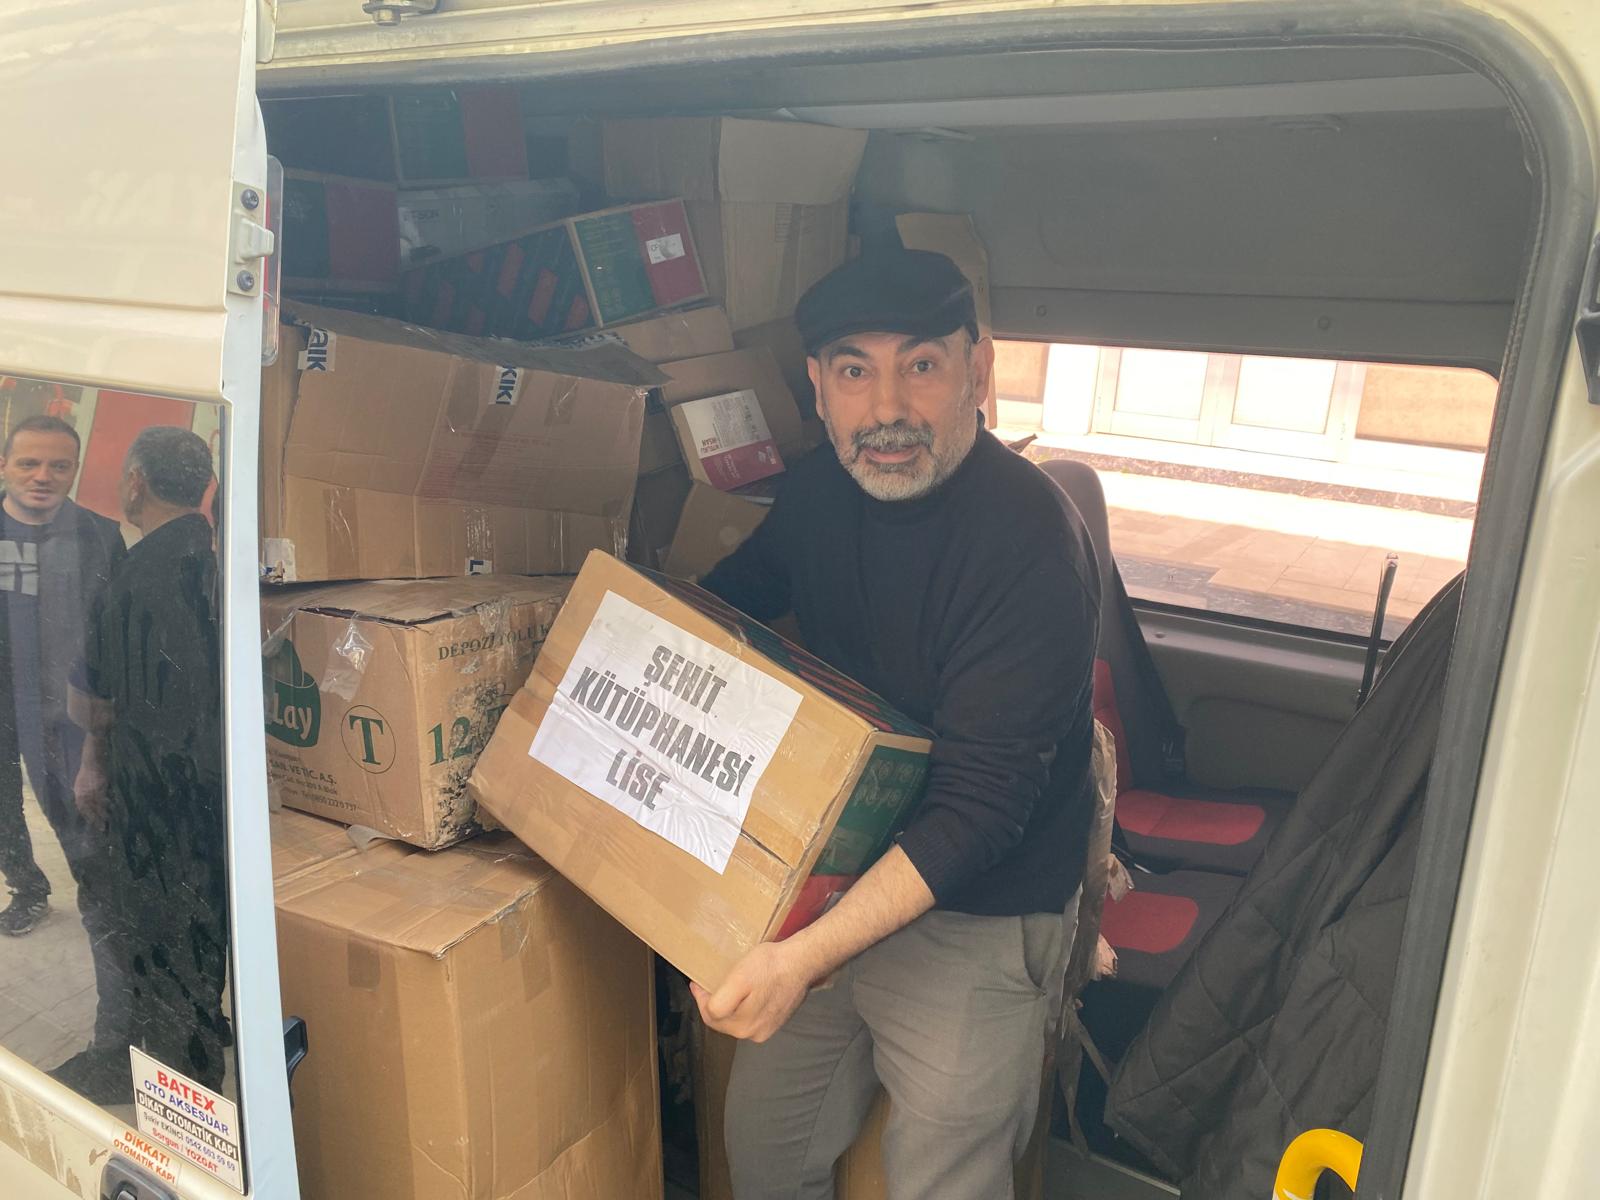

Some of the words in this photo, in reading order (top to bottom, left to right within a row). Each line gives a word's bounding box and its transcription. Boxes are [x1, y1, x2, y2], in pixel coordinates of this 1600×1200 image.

[644, 645, 728, 715] ŞEHİT
[349, 715, 384, 765] T
[569, 667, 755, 797] KÜTÜPHANESİ
[605, 748, 671, 811] LİSE
[144, 1080, 165, 1099] OTO
[169, 1094, 229, 1136] AKSESUAR
[157, 1070, 216, 1115] BATEX
[138, 1091, 164, 1118] DİKAT
[166, 1109, 214, 1146] OTOMATİK
[214, 1137, 238, 1161] KAPI
[155, 1164, 176, 1184] KAPI
[185, 1146, 219, 1174] YOZGAT
